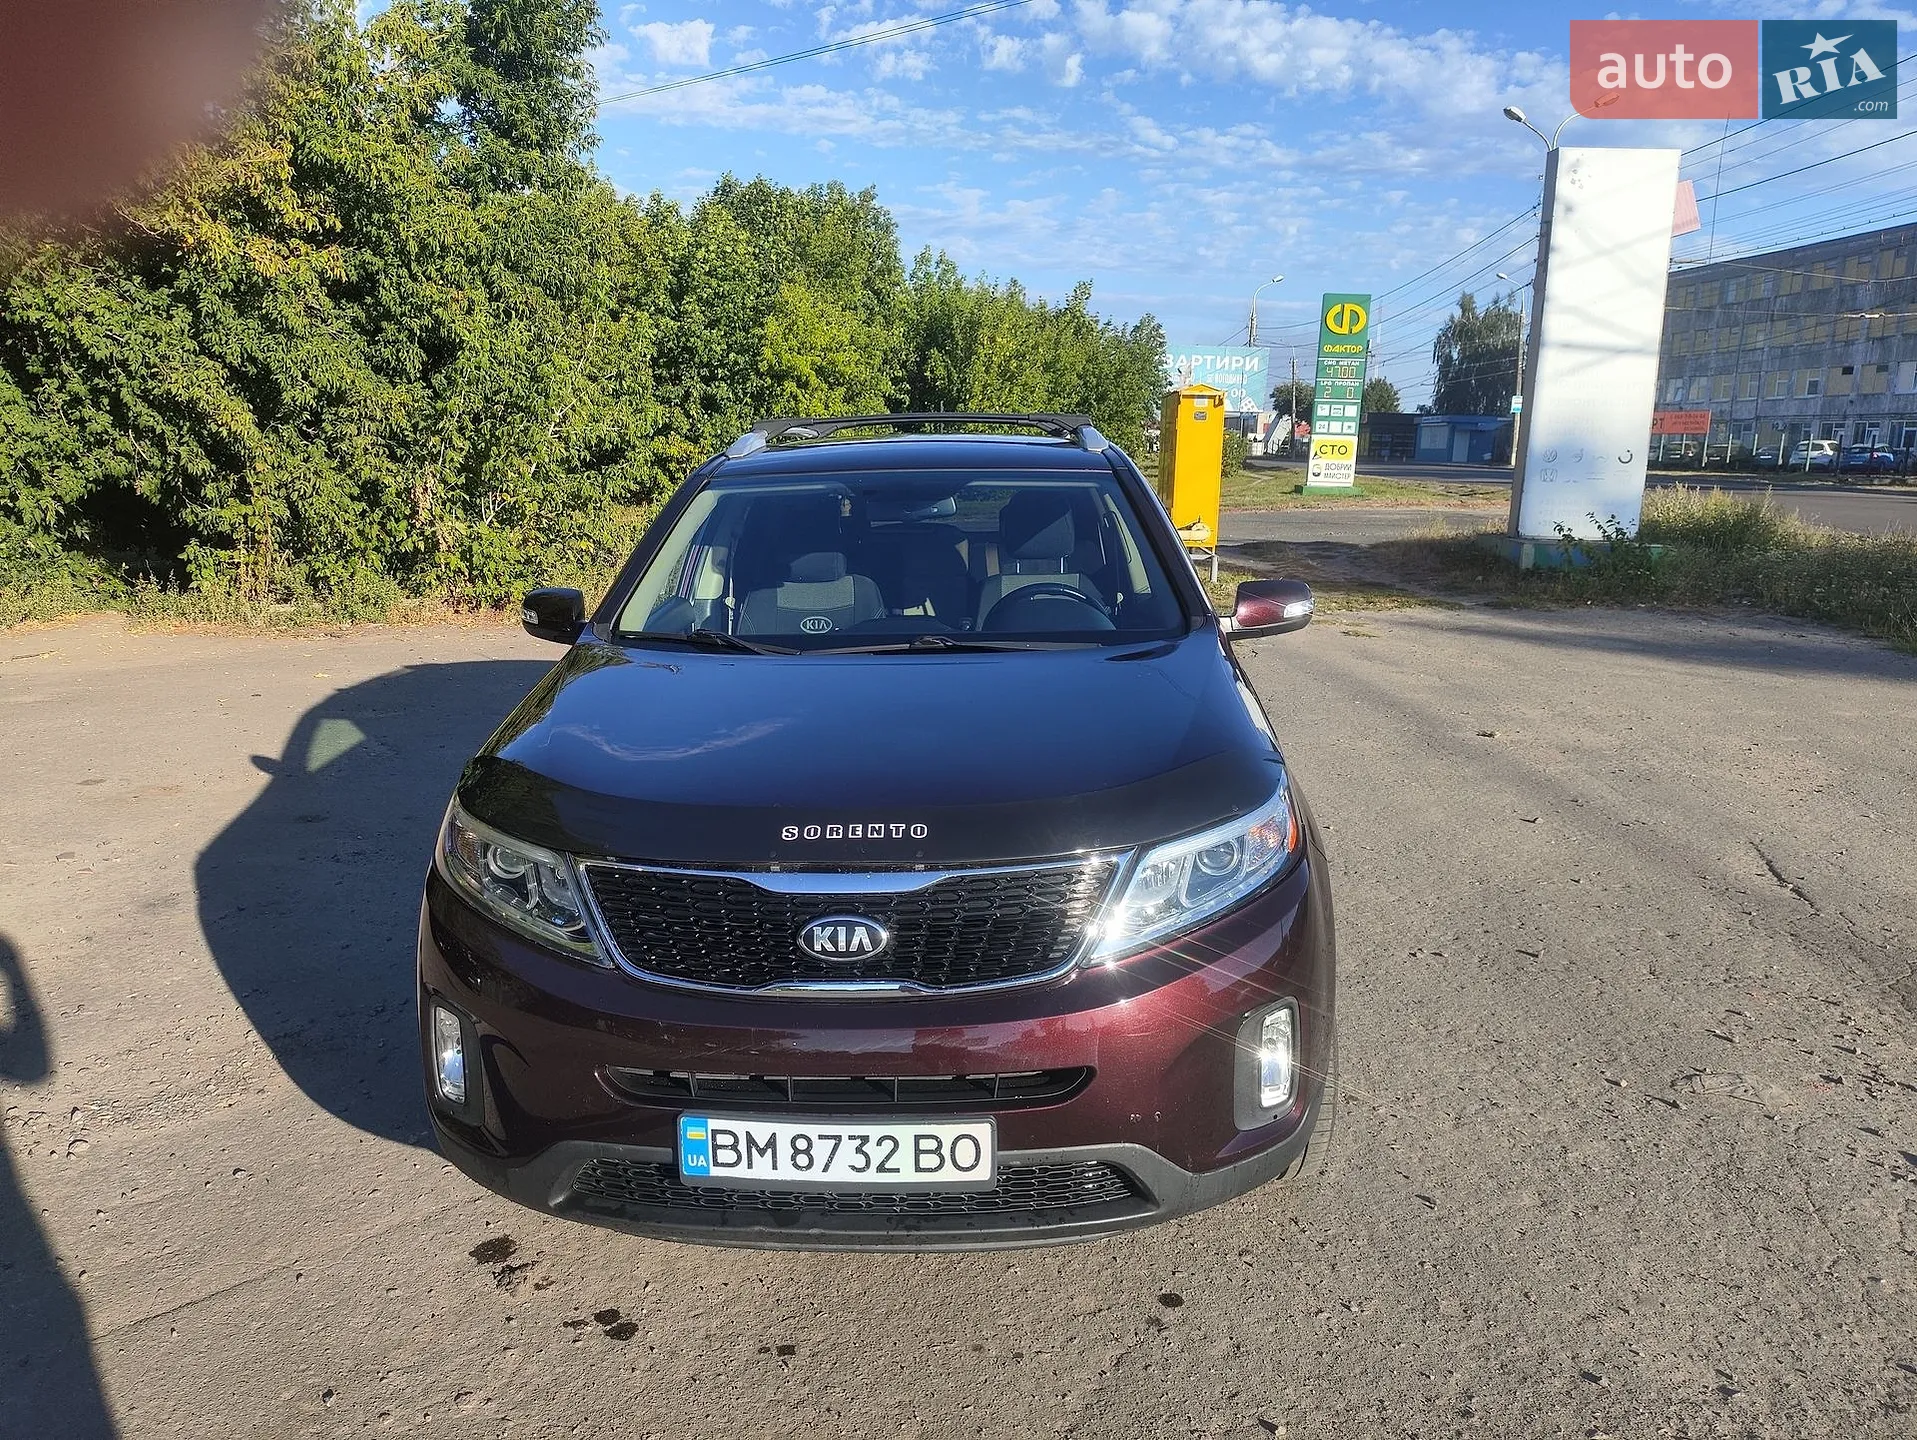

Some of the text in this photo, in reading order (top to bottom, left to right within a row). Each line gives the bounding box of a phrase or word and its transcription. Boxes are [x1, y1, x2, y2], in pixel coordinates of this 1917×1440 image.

[1323, 344, 1363, 354] ФАКТОР
[1162, 353, 1259, 372] ВАРТИРИ
[1319, 444, 1348, 455] СТО
[806, 619, 828, 630] KIA
[781, 823, 928, 841] SORENTO
[812, 926, 873, 952] KIA
[687, 1128, 982, 1174] UA BM 8732 BO
